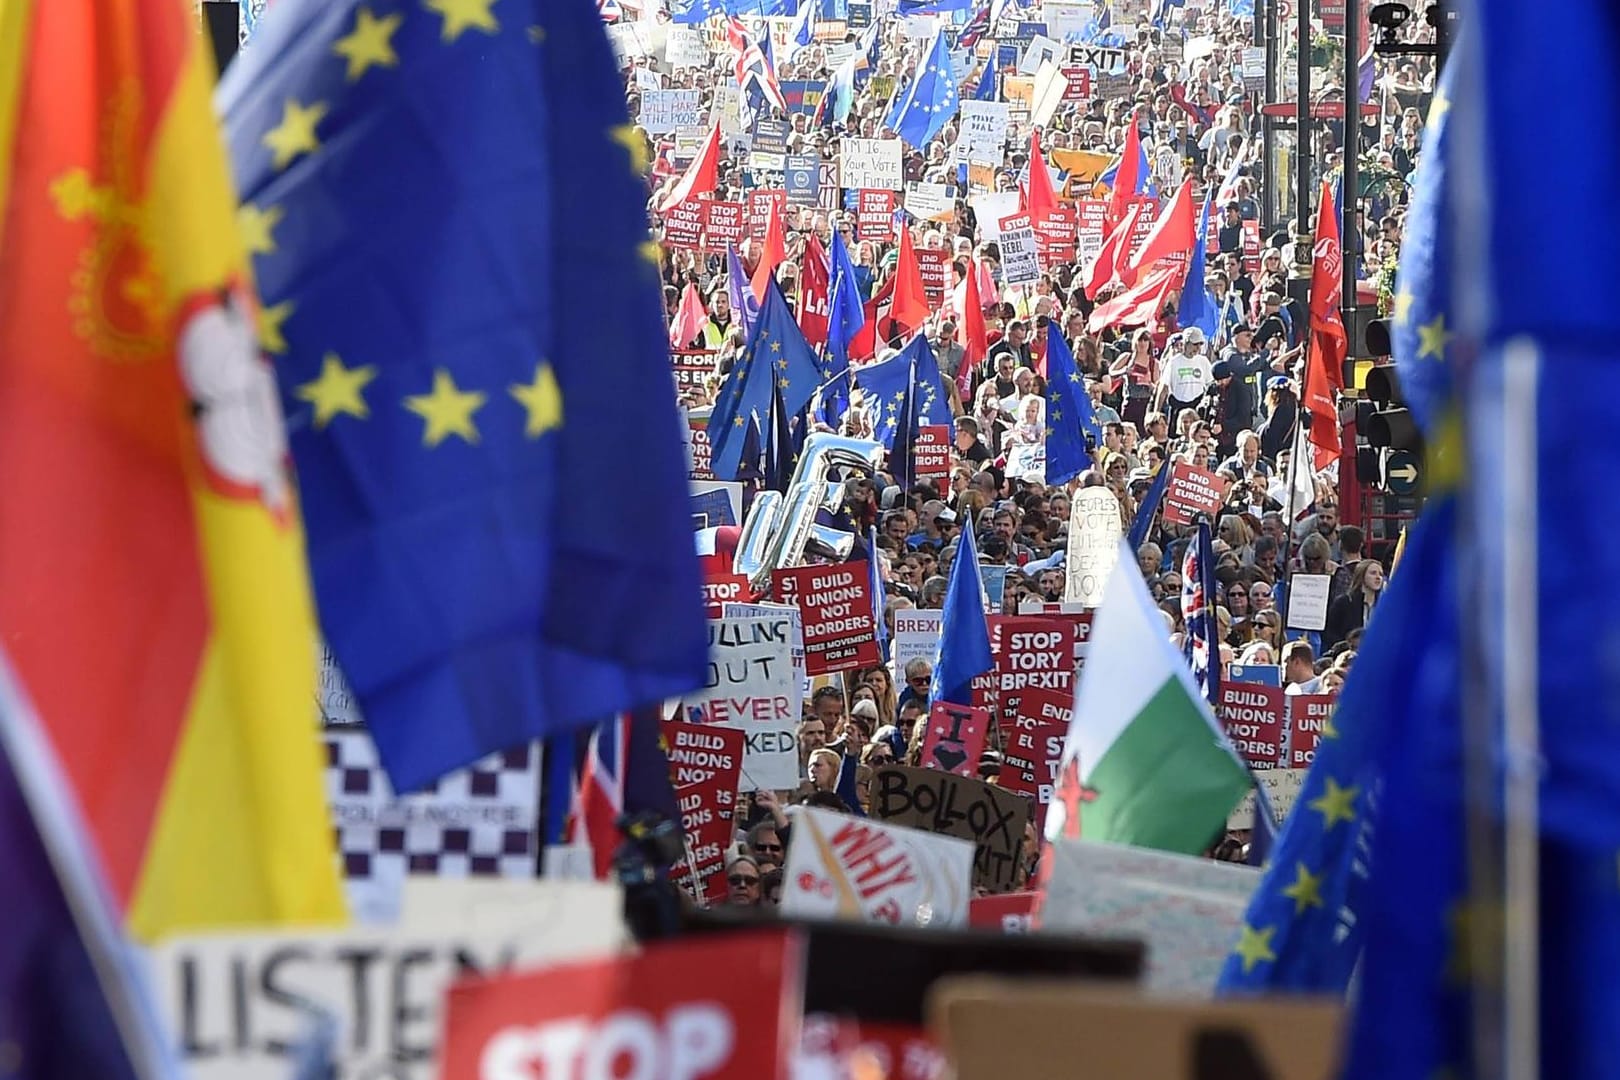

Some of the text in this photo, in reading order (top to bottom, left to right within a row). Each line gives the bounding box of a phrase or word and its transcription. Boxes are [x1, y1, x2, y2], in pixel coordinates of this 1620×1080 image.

[643, 91, 698, 101] BREXIT
[644, 102, 667, 112] WILL
[644, 114, 668, 124] THE
[864, 193, 888, 202] STOP
[712, 206, 738, 216] STOP
[864, 202, 888, 212] TORY
[673, 210, 700, 222] TORY
[710, 216, 736, 226] TORY
[860, 212, 892, 223] BREXIT
[1004, 216, 1030, 230] STOP
[1049, 213, 1065, 221] END
[668, 218, 702, 232] BREXIT
[707, 225, 741, 237] BREXIT
[922, 254, 938, 262] END
[1188, 472, 1210, 485] END
[1172, 478, 1220, 500] FORTRESS
[1175, 488, 1214, 507] EUROPE
[812, 572, 853, 590] BUILD
[806, 586, 864, 608] UNIONS
[820, 602, 852, 620] NOT
[805, 616, 870, 638] BORDERS
[896, 620, 940, 632] BREXI
[806, 633, 872, 653] FREE MOVEMENT
[1010, 632, 1062, 650] STOP
[826, 648, 857, 660] FOR ALL
[1008, 652, 1063, 670] TORY
[1001, 672, 1071, 690] BREXIT
[1224, 690, 1268, 707] BUILD
[687, 696, 792, 724] NEVER
[1042, 703, 1074, 722] END
[1226, 724, 1260, 738] NOT
[676, 732, 725, 750] BUILD
[666, 748, 732, 770] UNIONS
[1006, 756, 1026, 768] FREE
[1250, 760, 1276, 769] MENT
[678, 768, 716, 784] NOT
[680, 794, 702, 812] ILD
[878, 770, 1015, 852] BOLLOX
[682, 808, 712, 830] ONS
[478, 1002, 735, 1080] STOP
